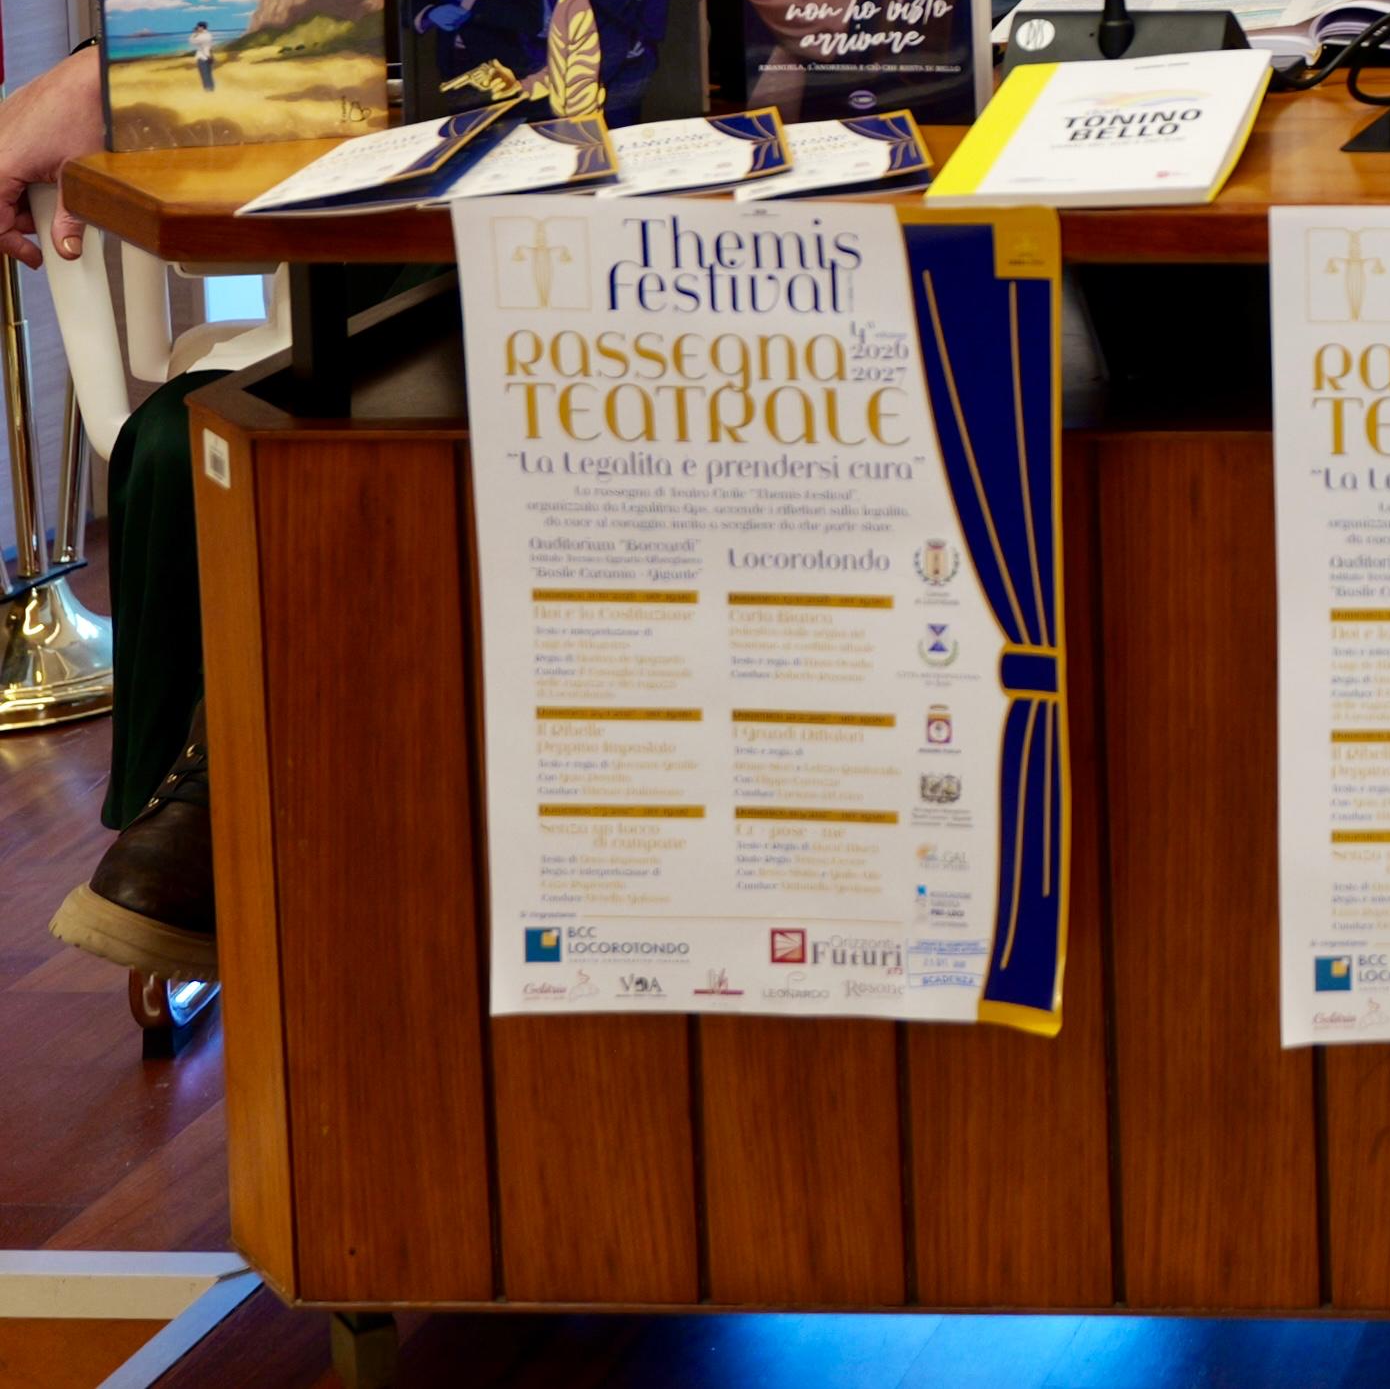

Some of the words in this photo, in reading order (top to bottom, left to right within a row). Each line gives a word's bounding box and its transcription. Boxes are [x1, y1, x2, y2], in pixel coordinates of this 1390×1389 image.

[786, 1, 842, 22] non
[800, 23, 926, 55] arrivare
[1064, 108, 1203, 130] TONINO
[1068, 123, 1181, 142] BELLO
[623, 215, 863, 271] Themis
[607, 258, 843, 314] festival
[850, 341, 909, 362] 2026
[852, 366, 907, 383] 2027
[707, 454, 840, 484] prendersi
[729, 548, 891, 571] Locorotondo
[568, 927, 596, 939] BCC
[568, 941, 690, 955] LOCOROTONDO
[811, 941, 902, 966] Futuri
[1358, 954, 1388, 967] BCC
